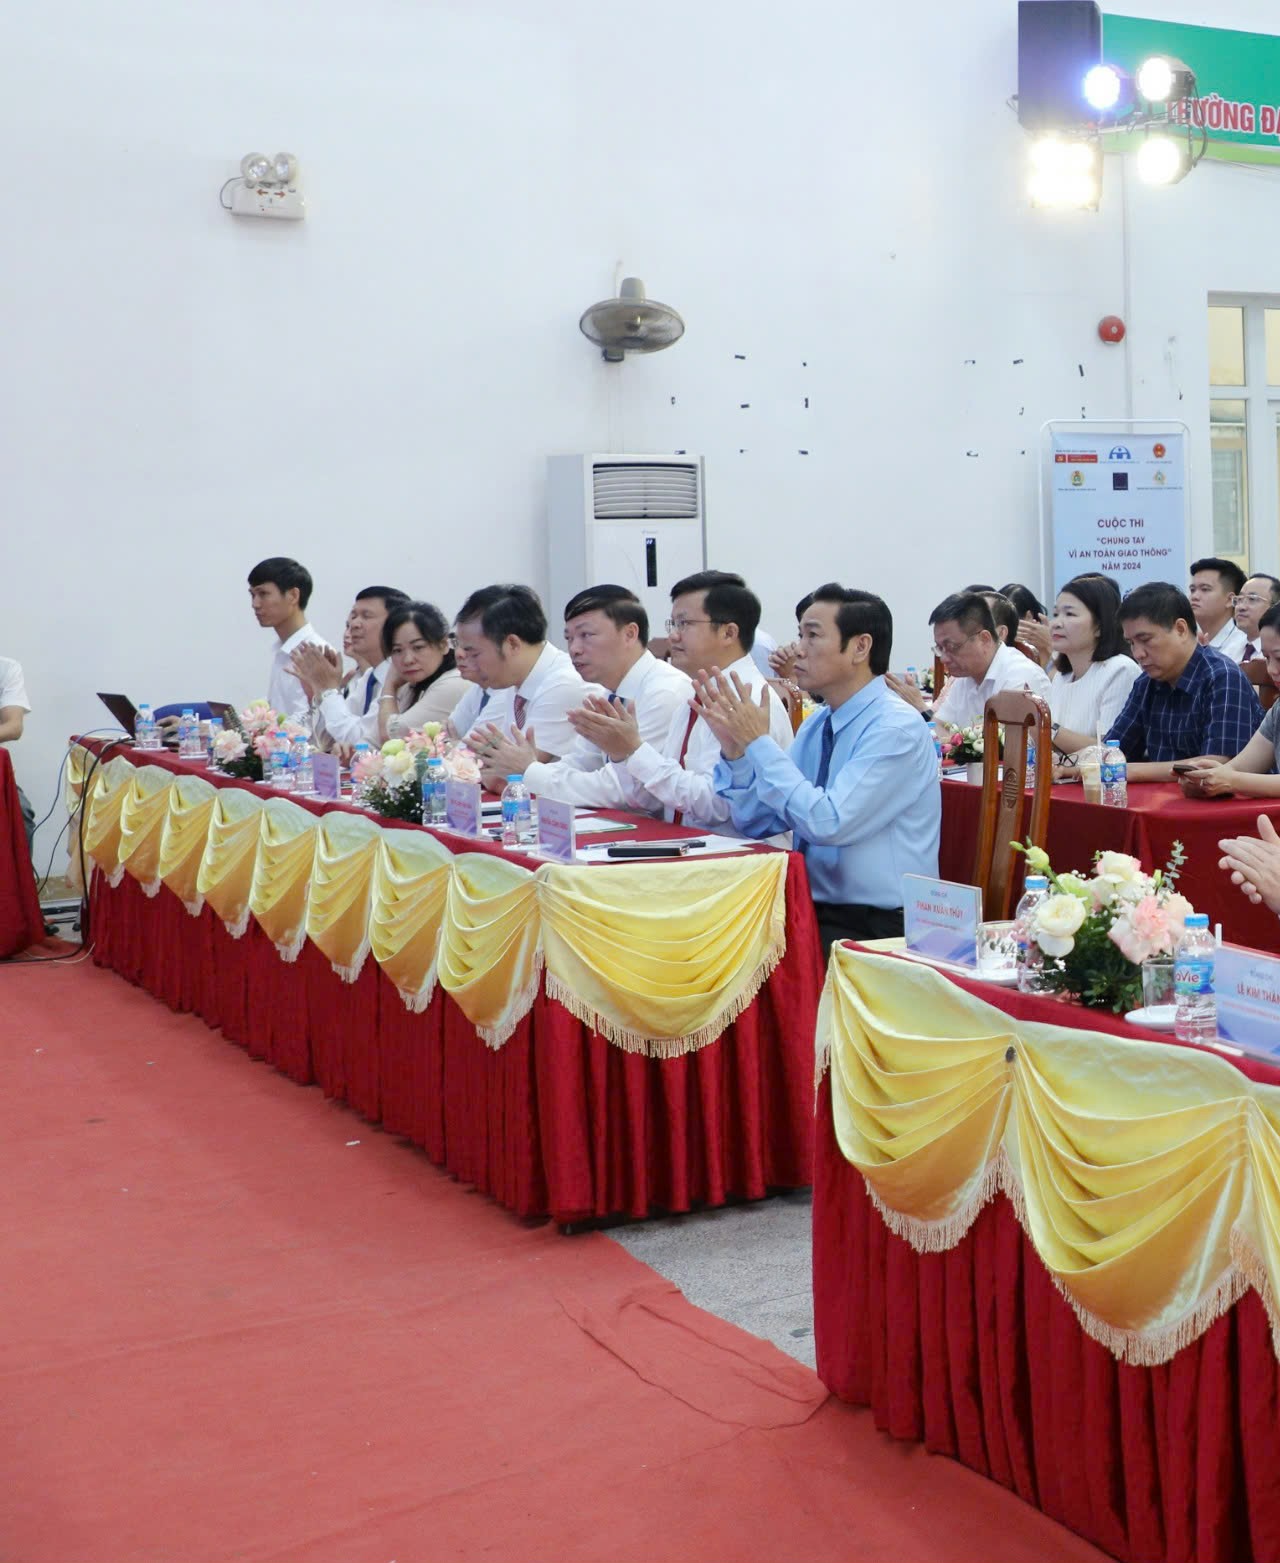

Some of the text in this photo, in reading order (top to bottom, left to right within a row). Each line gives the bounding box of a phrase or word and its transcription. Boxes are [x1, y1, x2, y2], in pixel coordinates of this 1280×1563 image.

[1097, 516, 1144, 530] CUỘC THI
[1133, 536, 1145, 544] TAY
[1069, 549, 1077, 558] VÌ
[1094, 547, 1115, 558] TOÀN
[1102, 562, 1141, 570] NĂM 2024
[1175, 970, 1199, 983] aVie
